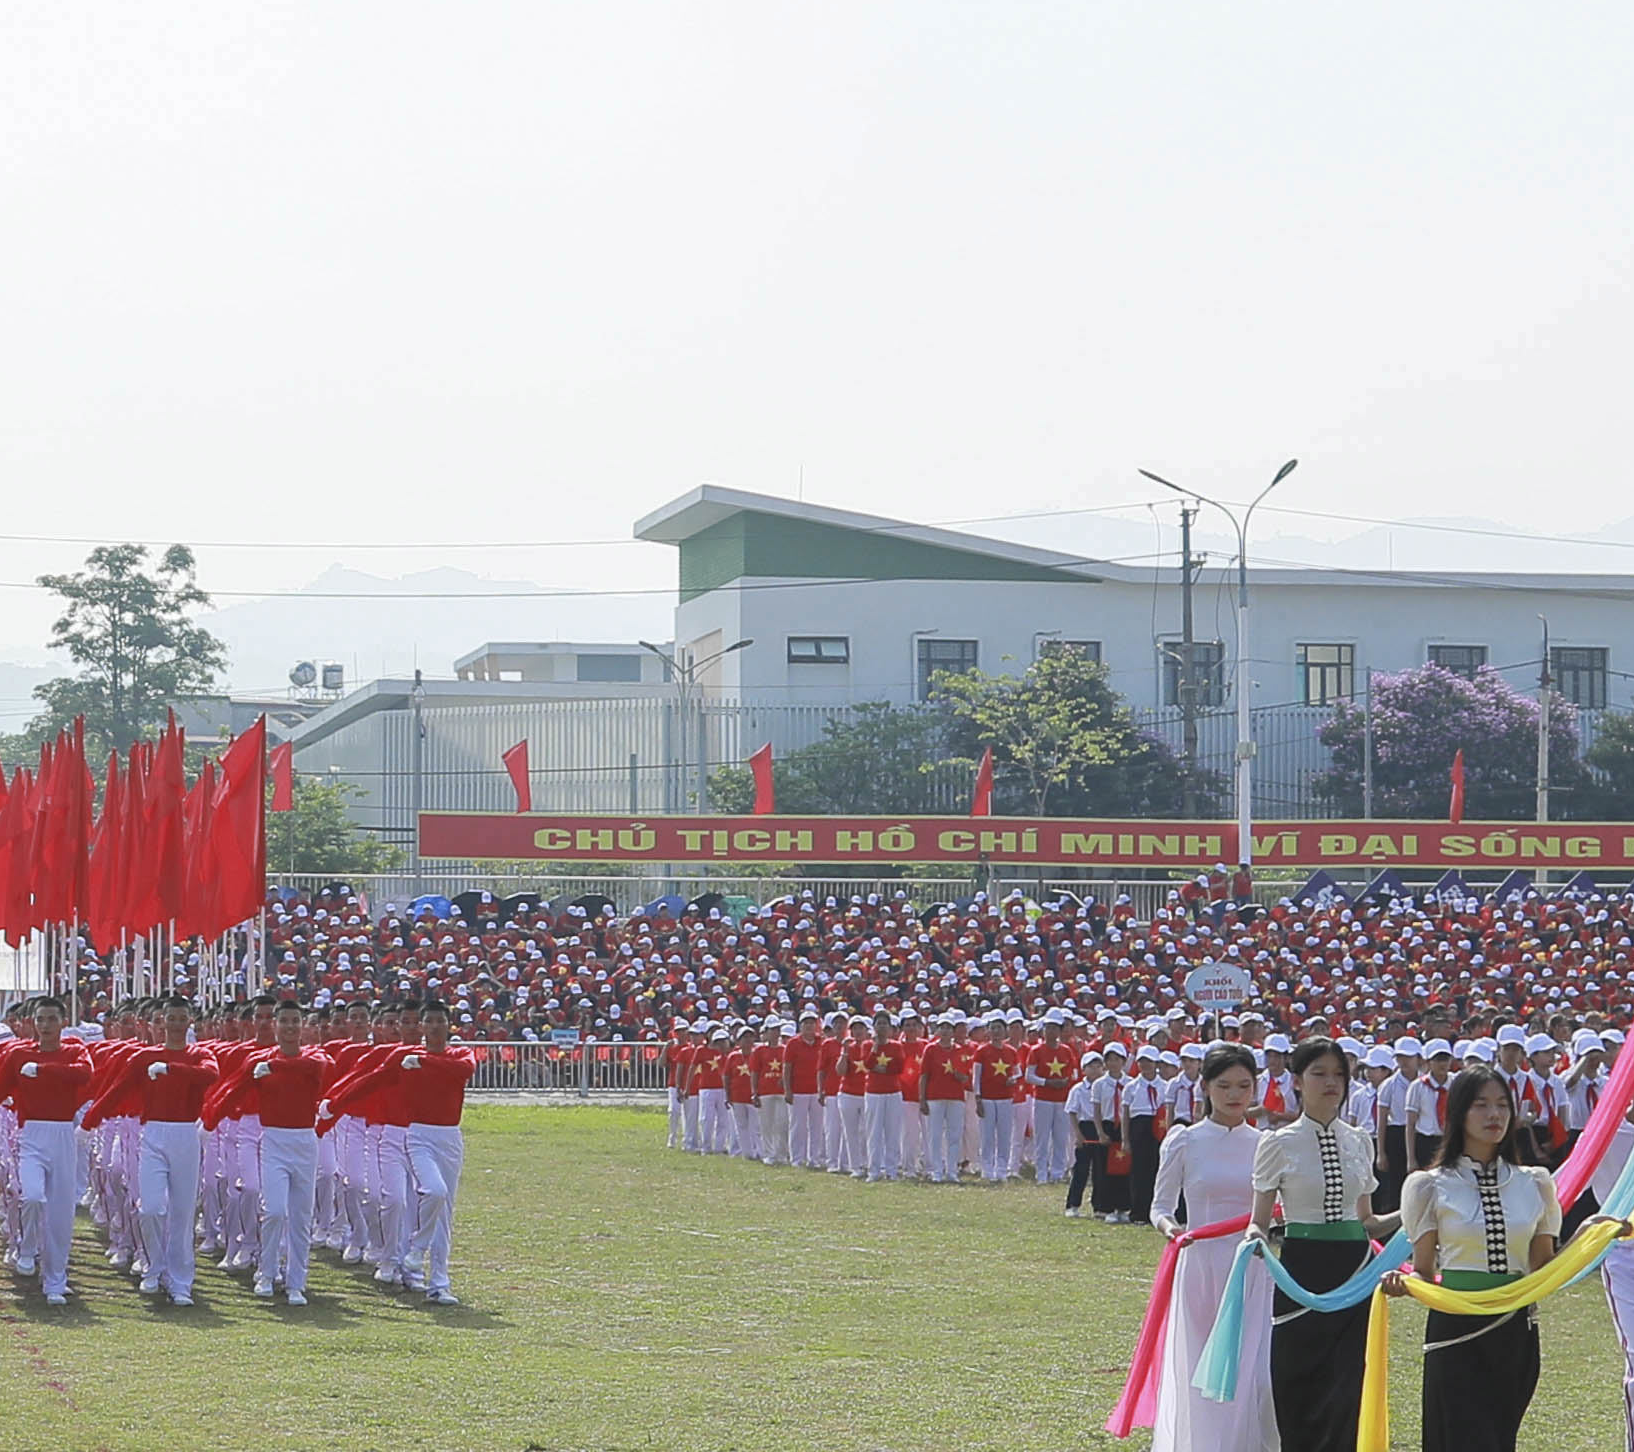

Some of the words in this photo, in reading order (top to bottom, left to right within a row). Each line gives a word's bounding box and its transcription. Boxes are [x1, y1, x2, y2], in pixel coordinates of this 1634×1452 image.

[534, 822, 657, 852] CHỦ
[677, 830, 813, 856] TỊCH
[836, 823, 916, 852] HỒ
[937, 827, 1038, 853] CHÍ
[1060, 834, 1222, 857] MINH
[1250, 831, 1302, 857] VĨ
[1317, 834, 1419, 860] ĐẠI
[1439, 828, 1601, 858] SỐNG
